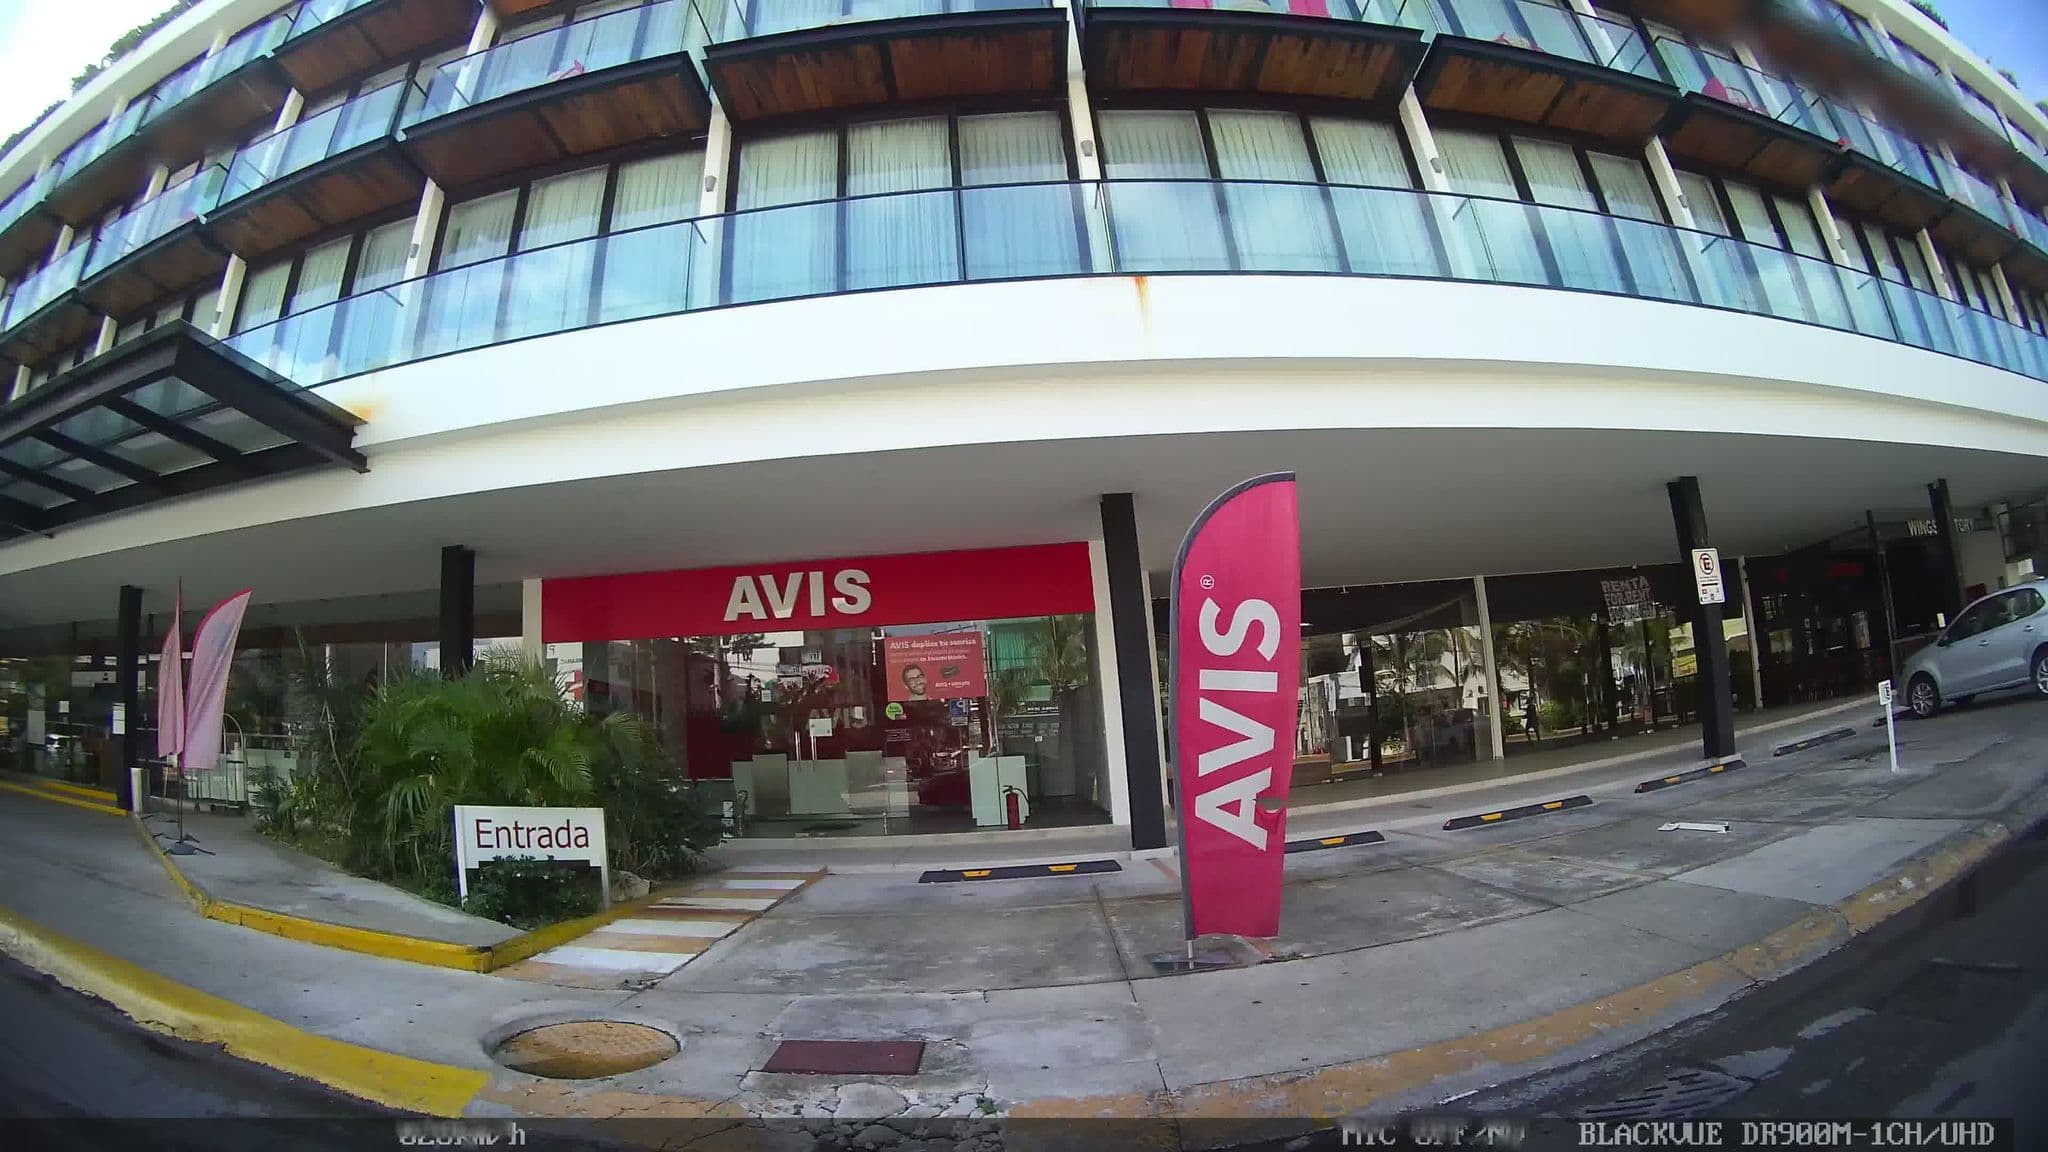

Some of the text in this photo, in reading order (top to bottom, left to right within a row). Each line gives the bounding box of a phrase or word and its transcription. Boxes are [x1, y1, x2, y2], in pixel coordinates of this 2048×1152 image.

[1907, 519, 1938, 536] WINGS
[723, 569, 872, 622] AVIS
[1601, 575, 1650, 593] RENTA
[475, 818, 590, 849] Entrada
